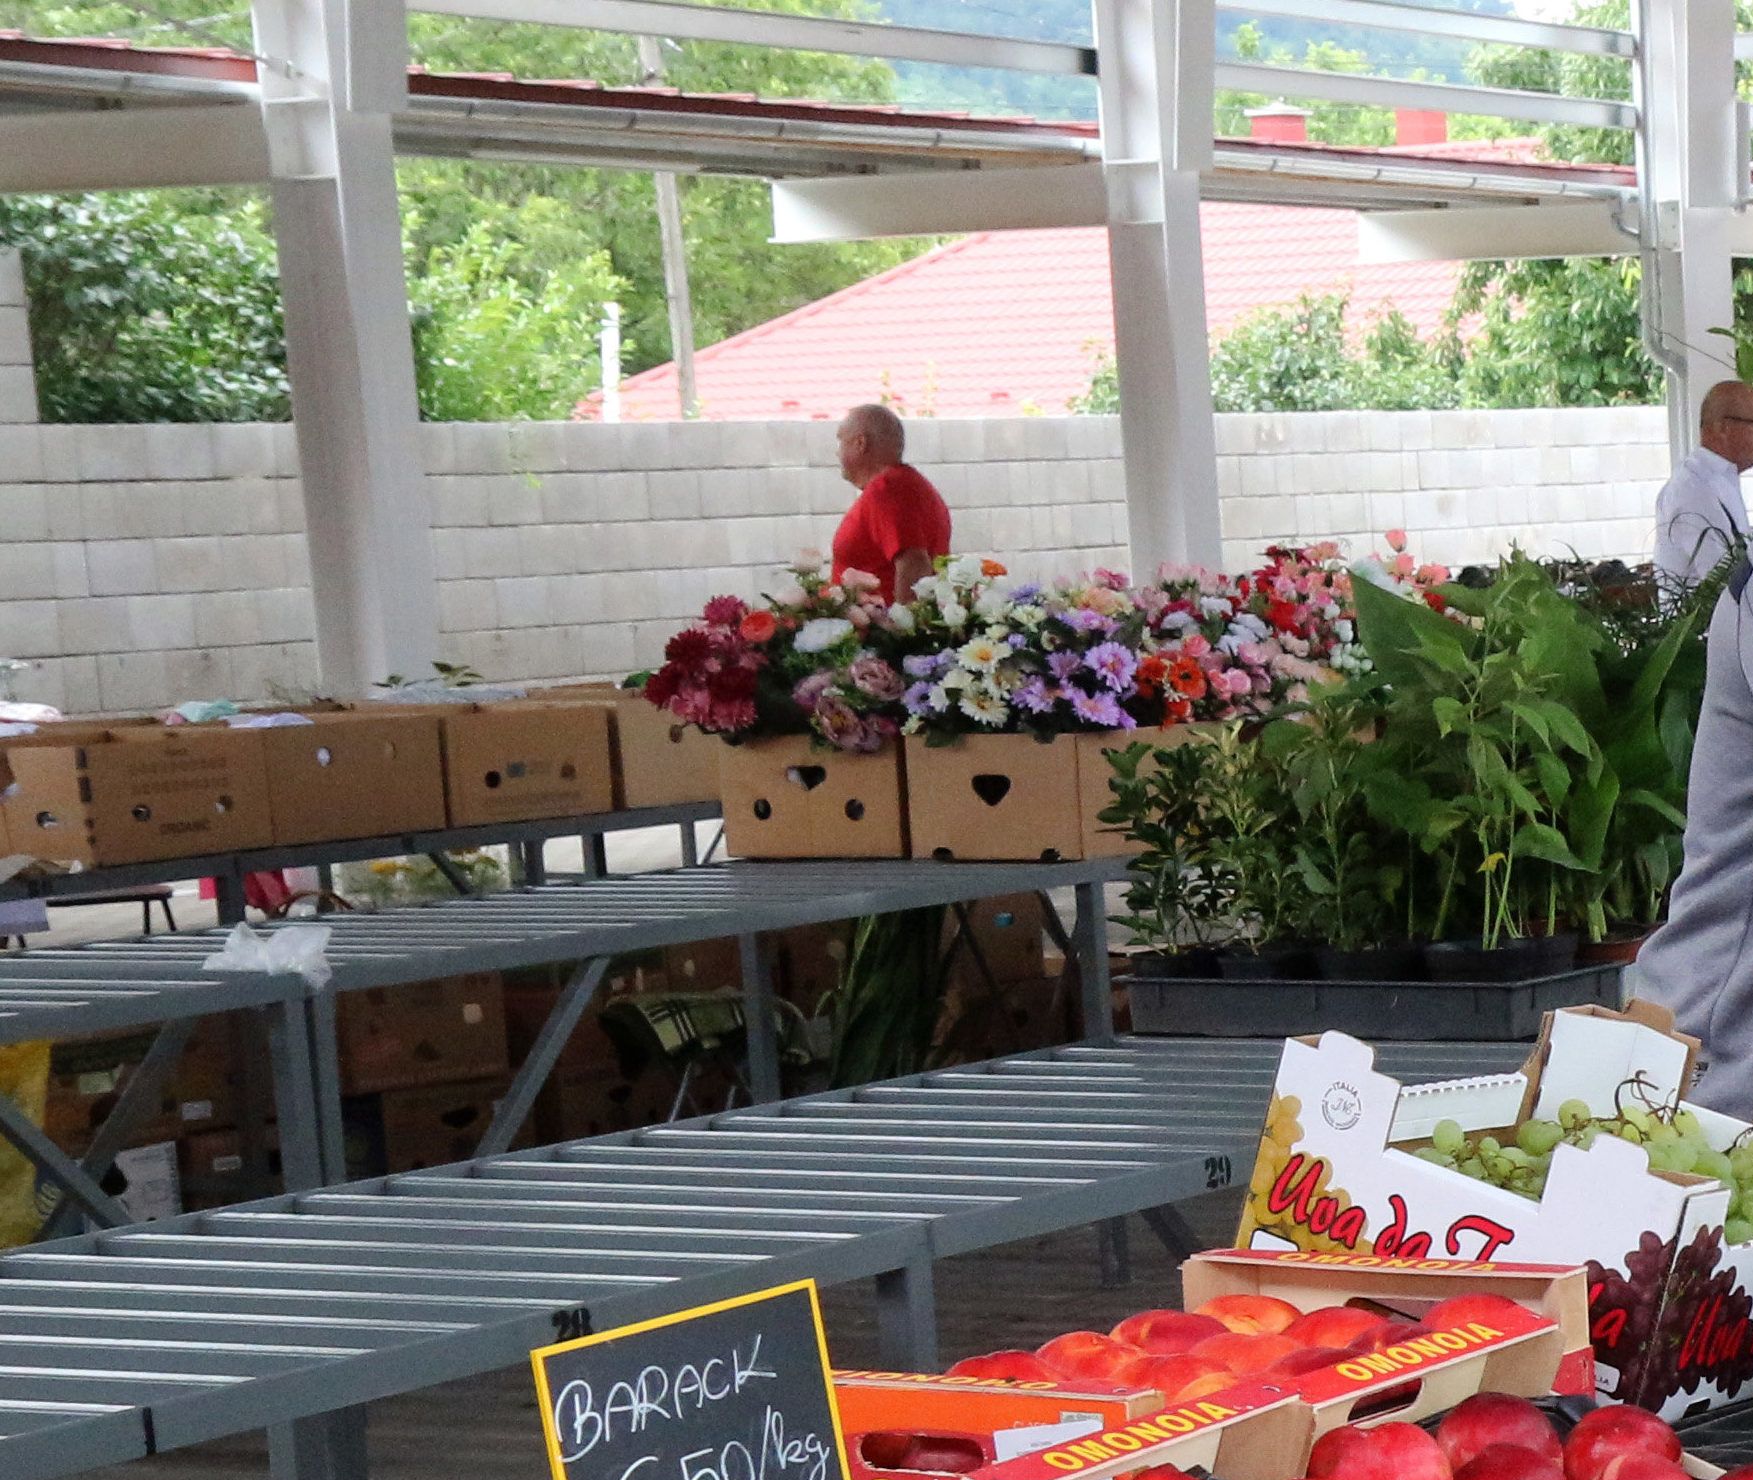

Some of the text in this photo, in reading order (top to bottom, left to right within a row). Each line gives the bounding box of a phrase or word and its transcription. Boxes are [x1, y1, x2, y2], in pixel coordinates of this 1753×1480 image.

[1204, 1154, 1232, 1188] 29
[1268, 1153, 1367, 1250] Uva
[1277, 1252, 1497, 1272] OMONOIA
[1336, 1321, 1505, 1382] OMONOIA
[555, 1334, 777, 1462] BARACK
[1043, 1401, 1239, 1471] OMONOIA
